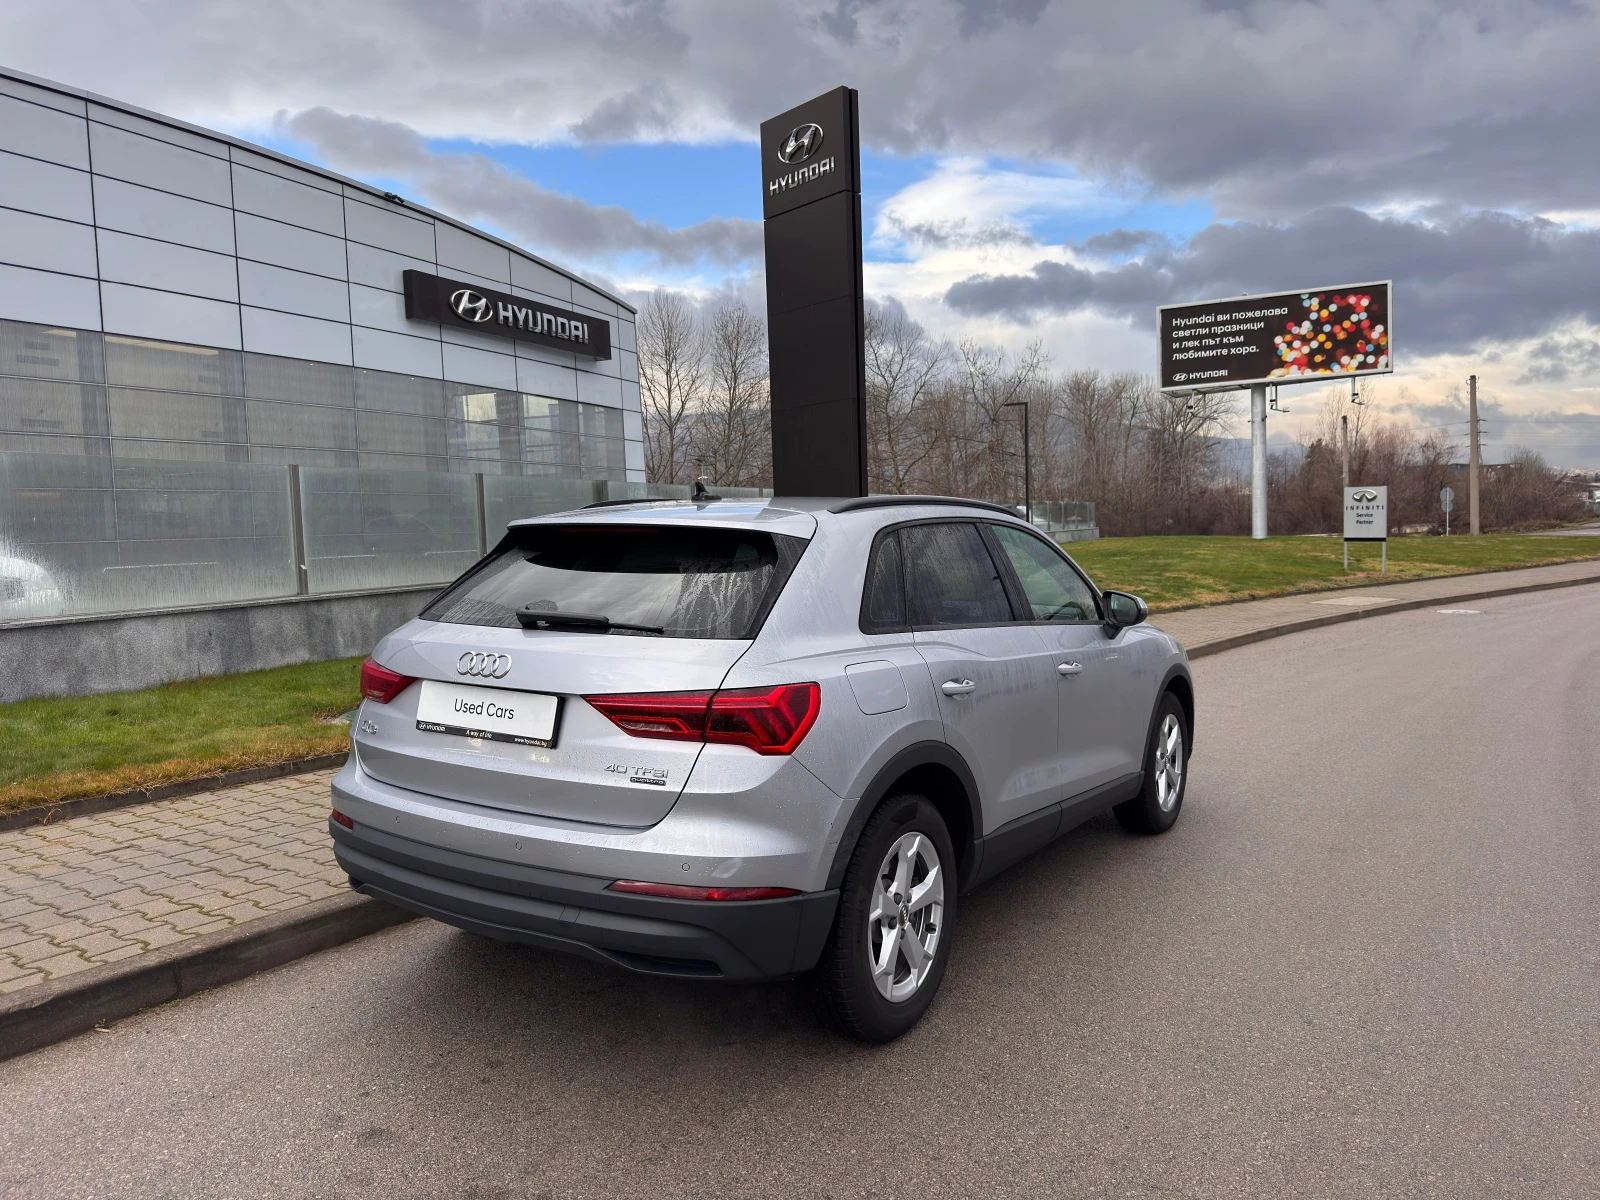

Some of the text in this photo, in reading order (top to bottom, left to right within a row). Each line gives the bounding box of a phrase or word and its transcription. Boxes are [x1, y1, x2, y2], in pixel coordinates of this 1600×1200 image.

[769, 156, 835, 196] HYUNDAI
[497, 301, 589, 344] HYUNDAI
[1172, 307, 1288, 327] Hyundai ви пожелава
[1172, 321, 1265, 338] светли празници
[1181, 340, 1200, 349] лек
[1202, 337, 1221, 347] път
[1222, 335, 1244, 344] към
[1172, 345, 1260, 361] любимите хора.
[1189, 369, 1228, 380] HYUNDAI
[454, 698, 515, 720] Used Cars
[604, 763, 669, 779] 40 TFSI
